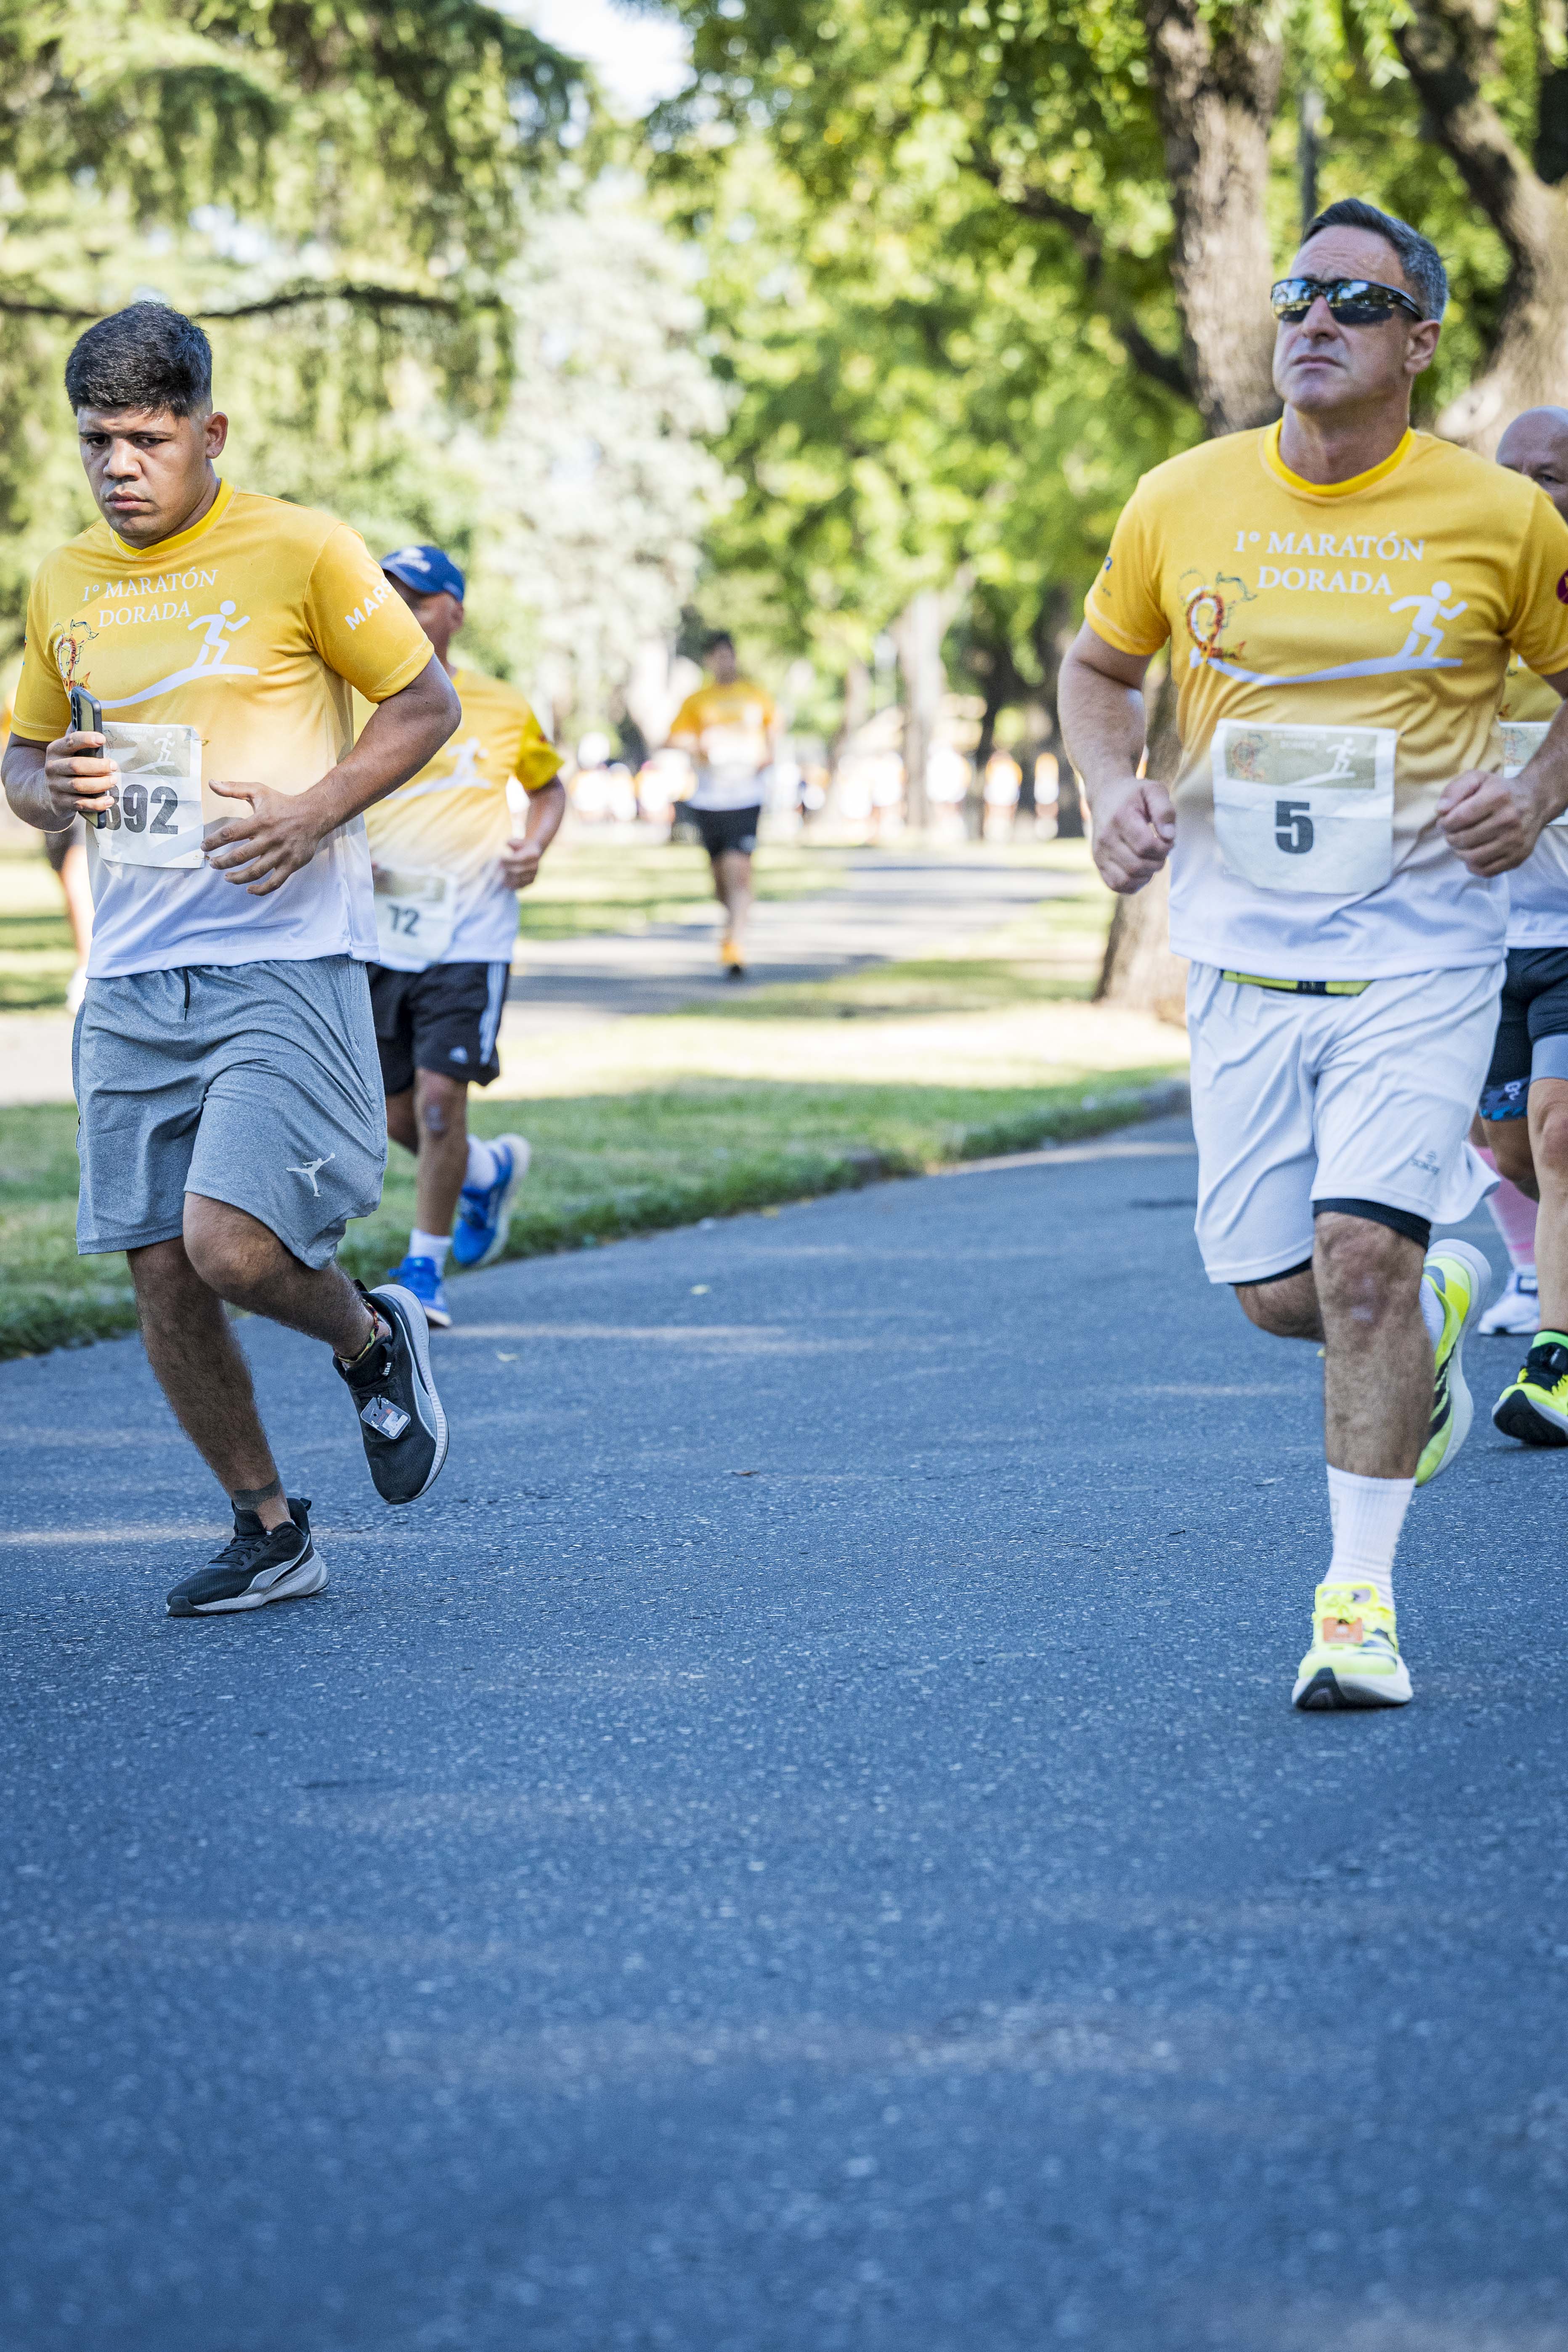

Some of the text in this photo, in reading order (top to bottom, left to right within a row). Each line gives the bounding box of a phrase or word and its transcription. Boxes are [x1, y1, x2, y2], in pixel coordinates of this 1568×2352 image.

[1266, 530, 1425, 561] MARATÓN
[104, 566, 219, 599] MARATÓN
[1257, 565, 1393, 595] DORADA
[98, 600, 191, 628] DORADA
[1276, 801, 1313, 854] 5
